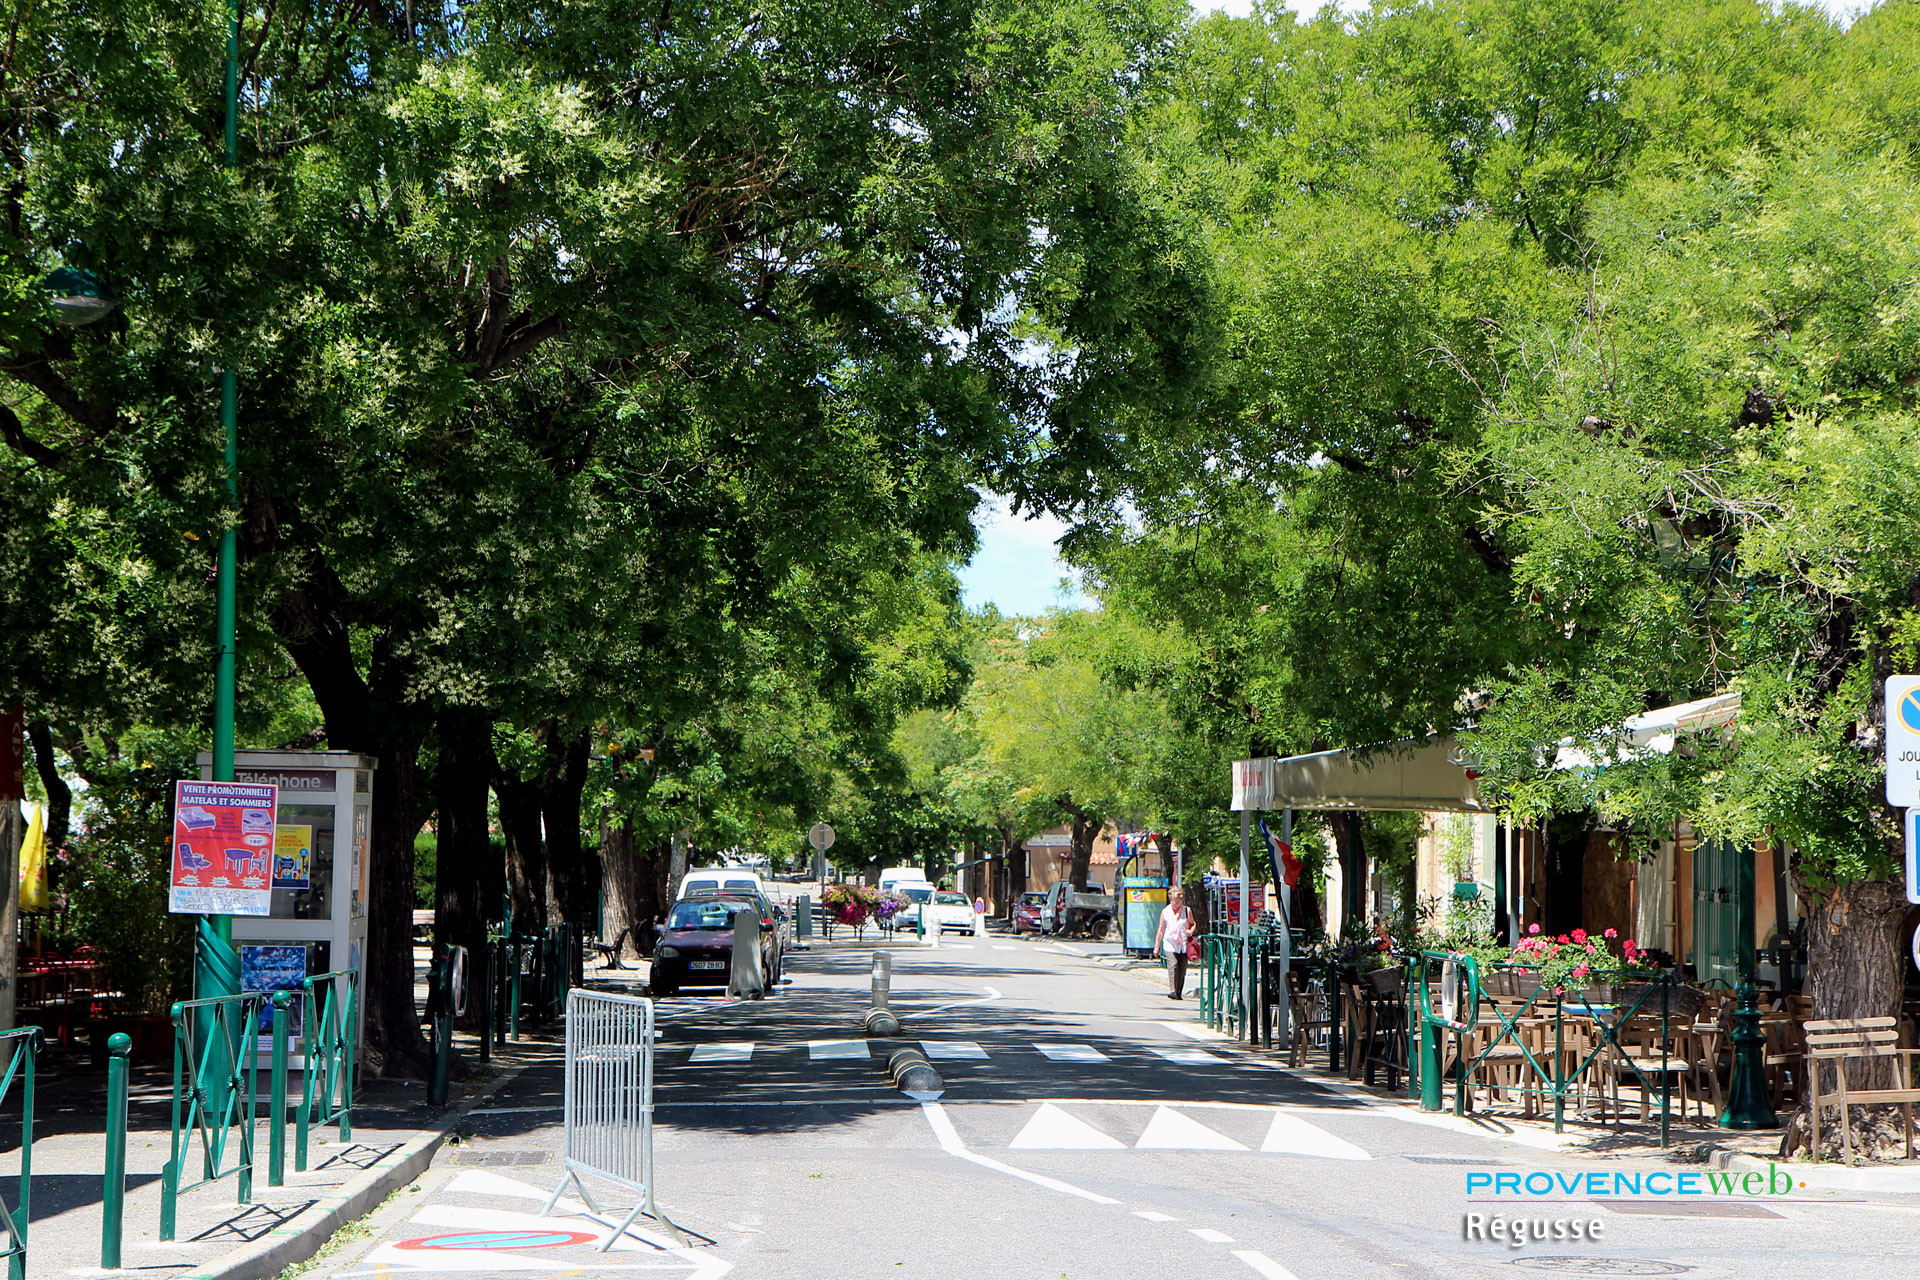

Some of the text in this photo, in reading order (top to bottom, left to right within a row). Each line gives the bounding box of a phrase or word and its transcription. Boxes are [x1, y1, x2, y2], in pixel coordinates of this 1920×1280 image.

[183, 785, 272, 797] VENTE PROMOTIONNELLE
[181, 796, 272, 808] MATELAS ET SOMMIERS
